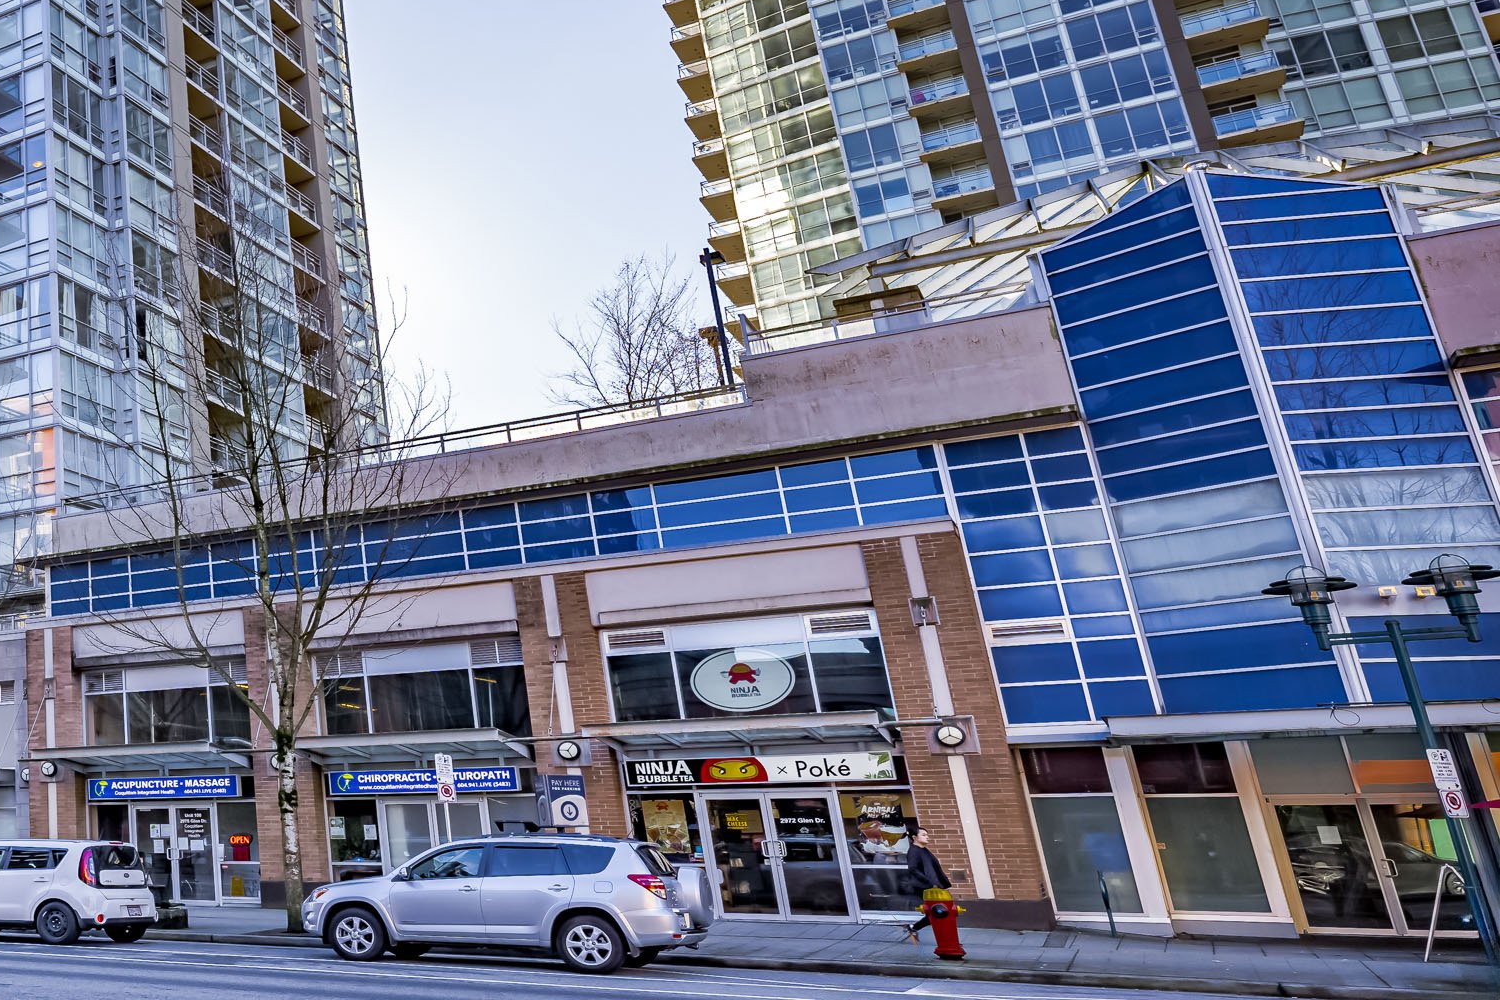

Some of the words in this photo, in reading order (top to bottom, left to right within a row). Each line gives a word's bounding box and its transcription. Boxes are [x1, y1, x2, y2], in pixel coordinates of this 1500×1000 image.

[635, 760, 692, 775] NINJA
[795, 757, 851, 778] Poké
[357, 772, 431, 783] CHIROPRACTIC
[452, 770, 510, 781] TUROPATH
[636, 775, 678, 783] BUBBLE
[111, 780, 179, 790] ACUPUNCTURE
[184, 778, 231, 788] MASSAGE
[230, 835, 250, 844] OPEN
